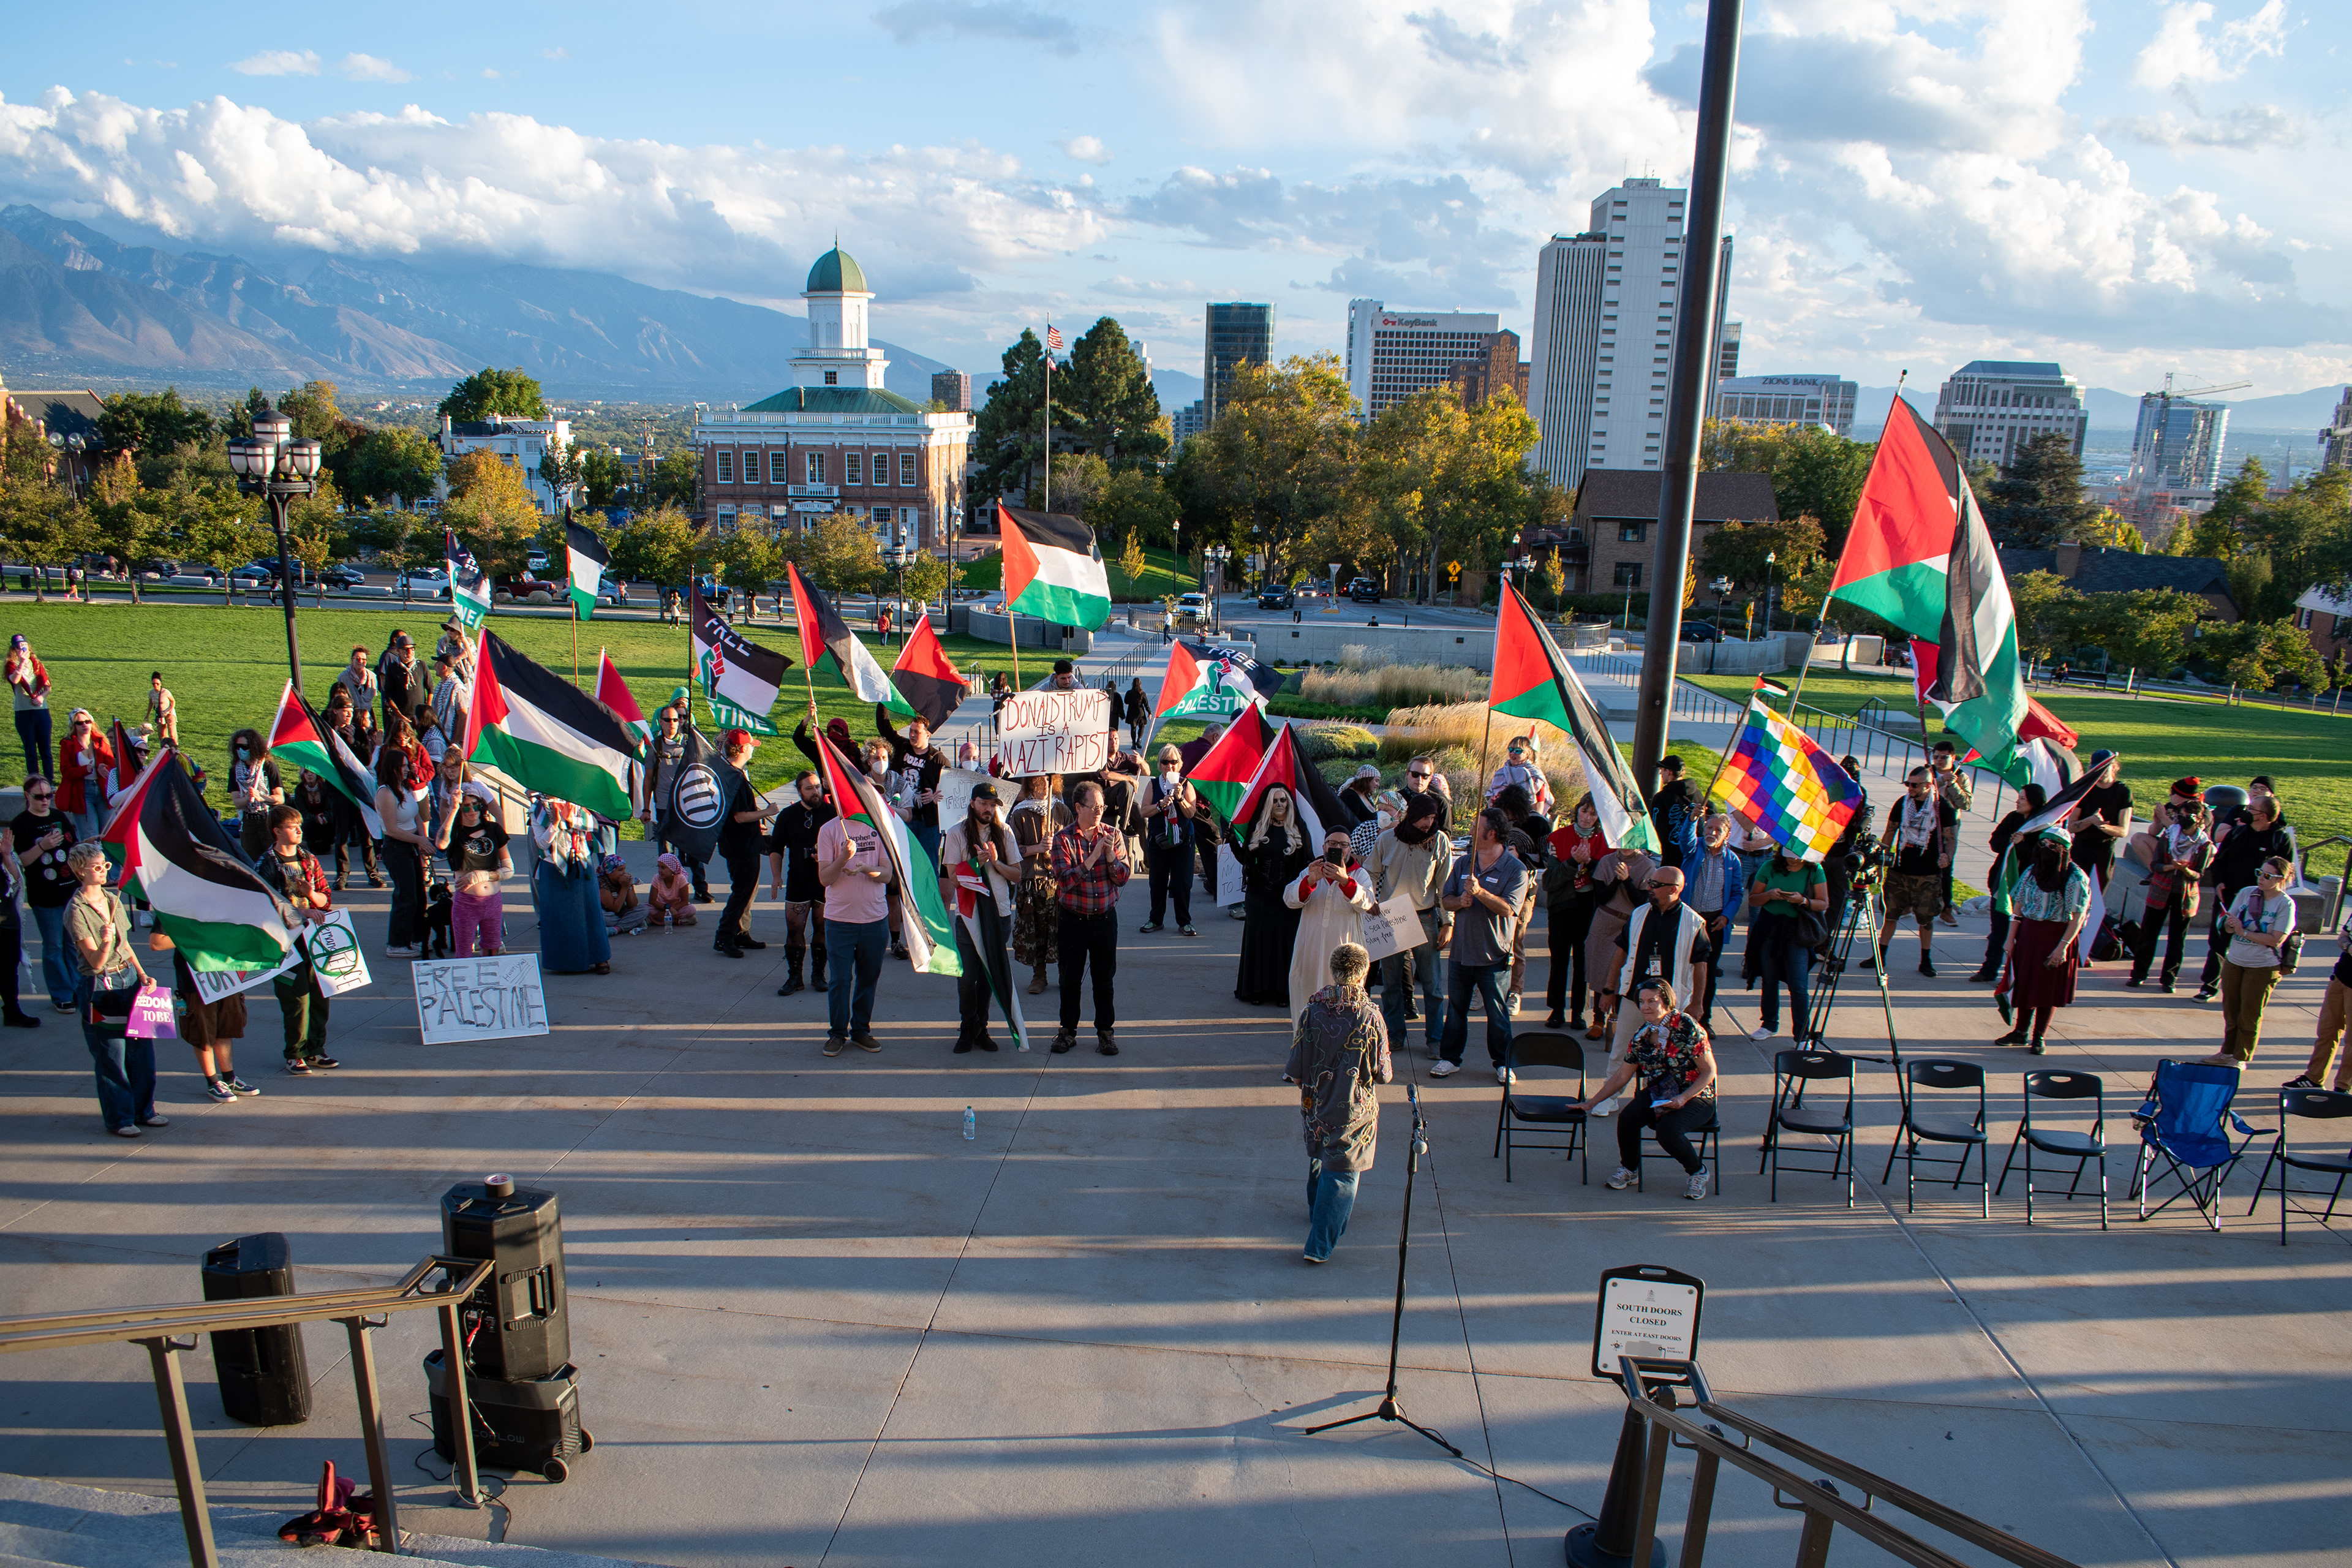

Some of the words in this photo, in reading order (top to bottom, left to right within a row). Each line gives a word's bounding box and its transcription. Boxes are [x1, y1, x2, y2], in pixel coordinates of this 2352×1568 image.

[1397, 317, 1438, 328] KeyBank
[1762, 377, 1790, 385] ZIONS
[1208, 647, 1260, 671] FREE
[1006, 694, 1060, 731] DONALD
[1057, 692, 1108, 722] TRUMP
[1174, 694, 1251, 714] PALESTIN
[1036, 725, 1056, 737] IS
[1061, 721, 1069, 736] A
[1000, 739, 1049, 777] NAZI
[1055, 730, 1108, 772] RAPIST
[1221, 862, 1235, 878] MY
[1221, 881, 1234, 895] TO
[1369, 924, 1381, 932] sea
[1380, 914, 1407, 929] Palestine
[326, 949, 363, 990] PEACE
[415, 961, 500, 996] FREE
[143, 1010, 156, 1022] TO
[156, 1011, 171, 1022] BE
[1616, 1303, 1648, 1313] SOUTH
[1650, 1306, 1683, 1316] DOORS
[1629, 1316, 1667, 1326] CLOSED
